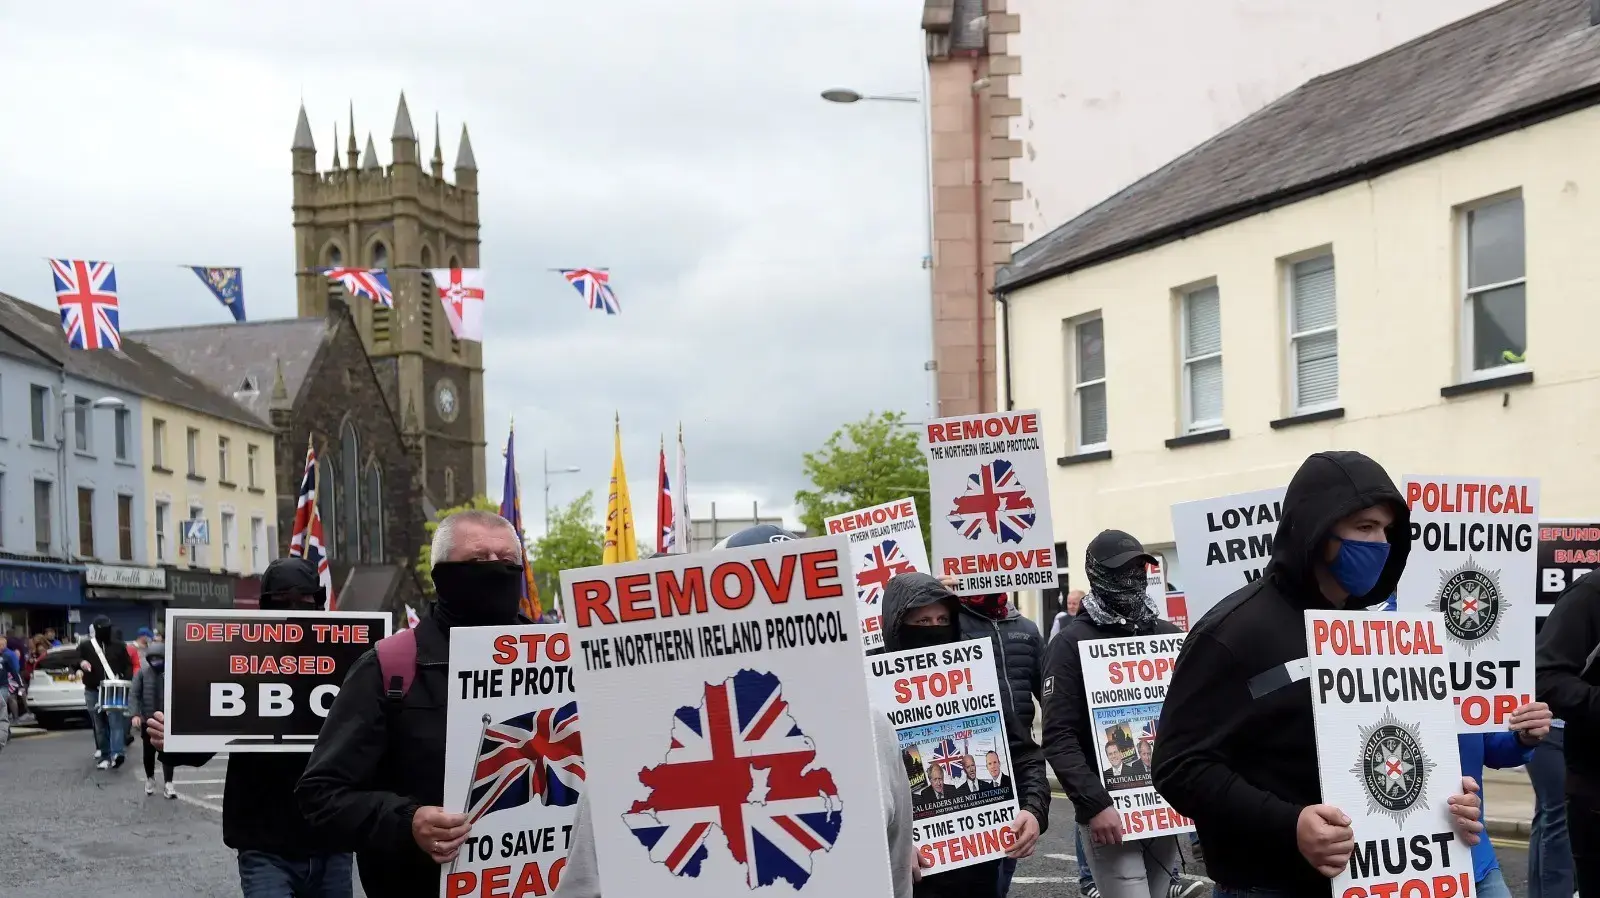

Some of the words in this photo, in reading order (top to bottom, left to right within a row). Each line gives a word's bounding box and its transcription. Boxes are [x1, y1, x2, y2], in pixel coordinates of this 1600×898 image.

[928, 414, 1038, 443] REMOVE
[931, 447, 944, 460] THE
[945, 443, 978, 458] NORTHERN
[980, 440, 1006, 455] IRELAND
[1007, 437, 1040, 452] PROTOCOL
[1407, 482, 1534, 514] POLITICAL
[829, 501, 914, 535] REMOVE
[870, 524, 891, 538] IRELAND
[890, 519, 917, 534] PROTOCOL
[1410, 522, 1532, 552] POLICING
[943, 549, 1053, 576] REMOVE
[171, 576, 229, 601] Hampton
[571, 549, 844, 629] REMOVE
[967, 576, 992, 590] IRISH
[995, 573, 1013, 587] SEA
[1015, 570, 1054, 585] BORDER
[1442, 573, 1466, 599] POLICE
[1474, 573, 1498, 602] SERVICE
[186, 623, 303, 643] DEFUND
[312, 625, 370, 643] THE
[1313, 619, 1443, 656] POLITICAL
[1444, 611, 1466, 637] ORTHERN
[1475, 613, 1496, 637] IRELAND
[492, 632, 572, 665] STO
[580, 636, 612, 671] THE
[614, 627, 696, 668] NORTHERN
[697, 619, 762, 658] IRELAND
[767, 610, 848, 649] PROTOCOL
[1089, 641, 1147, 659] ULSTER
[1150, 638, 1184, 653] SAYS
[230, 655, 336, 675] BIASED
[871, 652, 938, 677] ULSTER
[942, 645, 983, 665] SAYS
[1449, 660, 1520, 691] UST
[458, 669, 503, 700] THE
[894, 667, 973, 704] STOP!
[1091, 687, 1142, 704] IGNORING
[1144, 685, 1166, 700] OUR
[1318, 666, 1447, 704] POLICING
[935, 699, 959, 718] OUR
[961, 693, 996, 712] VOICE
[1453, 694, 1530, 726] OP
[954, 729, 973, 740] YOUR
[962, 715, 997, 730] IRELAND
[1365, 728, 1385, 761] POLICE
[1395, 728, 1420, 760] SERVICE
[924, 798, 952, 811] LEADERS
[952, 797, 965, 805] ARE
[964, 793, 979, 801] NOT
[978, 786, 1010, 799] LISTENING!
[1133, 791, 1162, 806] TIME
[1367, 775, 1393, 807] NORTHERN
[1404, 776, 1422, 805] IRELAND
[922, 820, 955, 839] TIME
[958, 815, 975, 831] TO
[977, 806, 1015, 827] START
[465, 835, 494, 862] TO
[500, 827, 555, 858] SAVE
[1350, 832, 1454, 879] MUST
